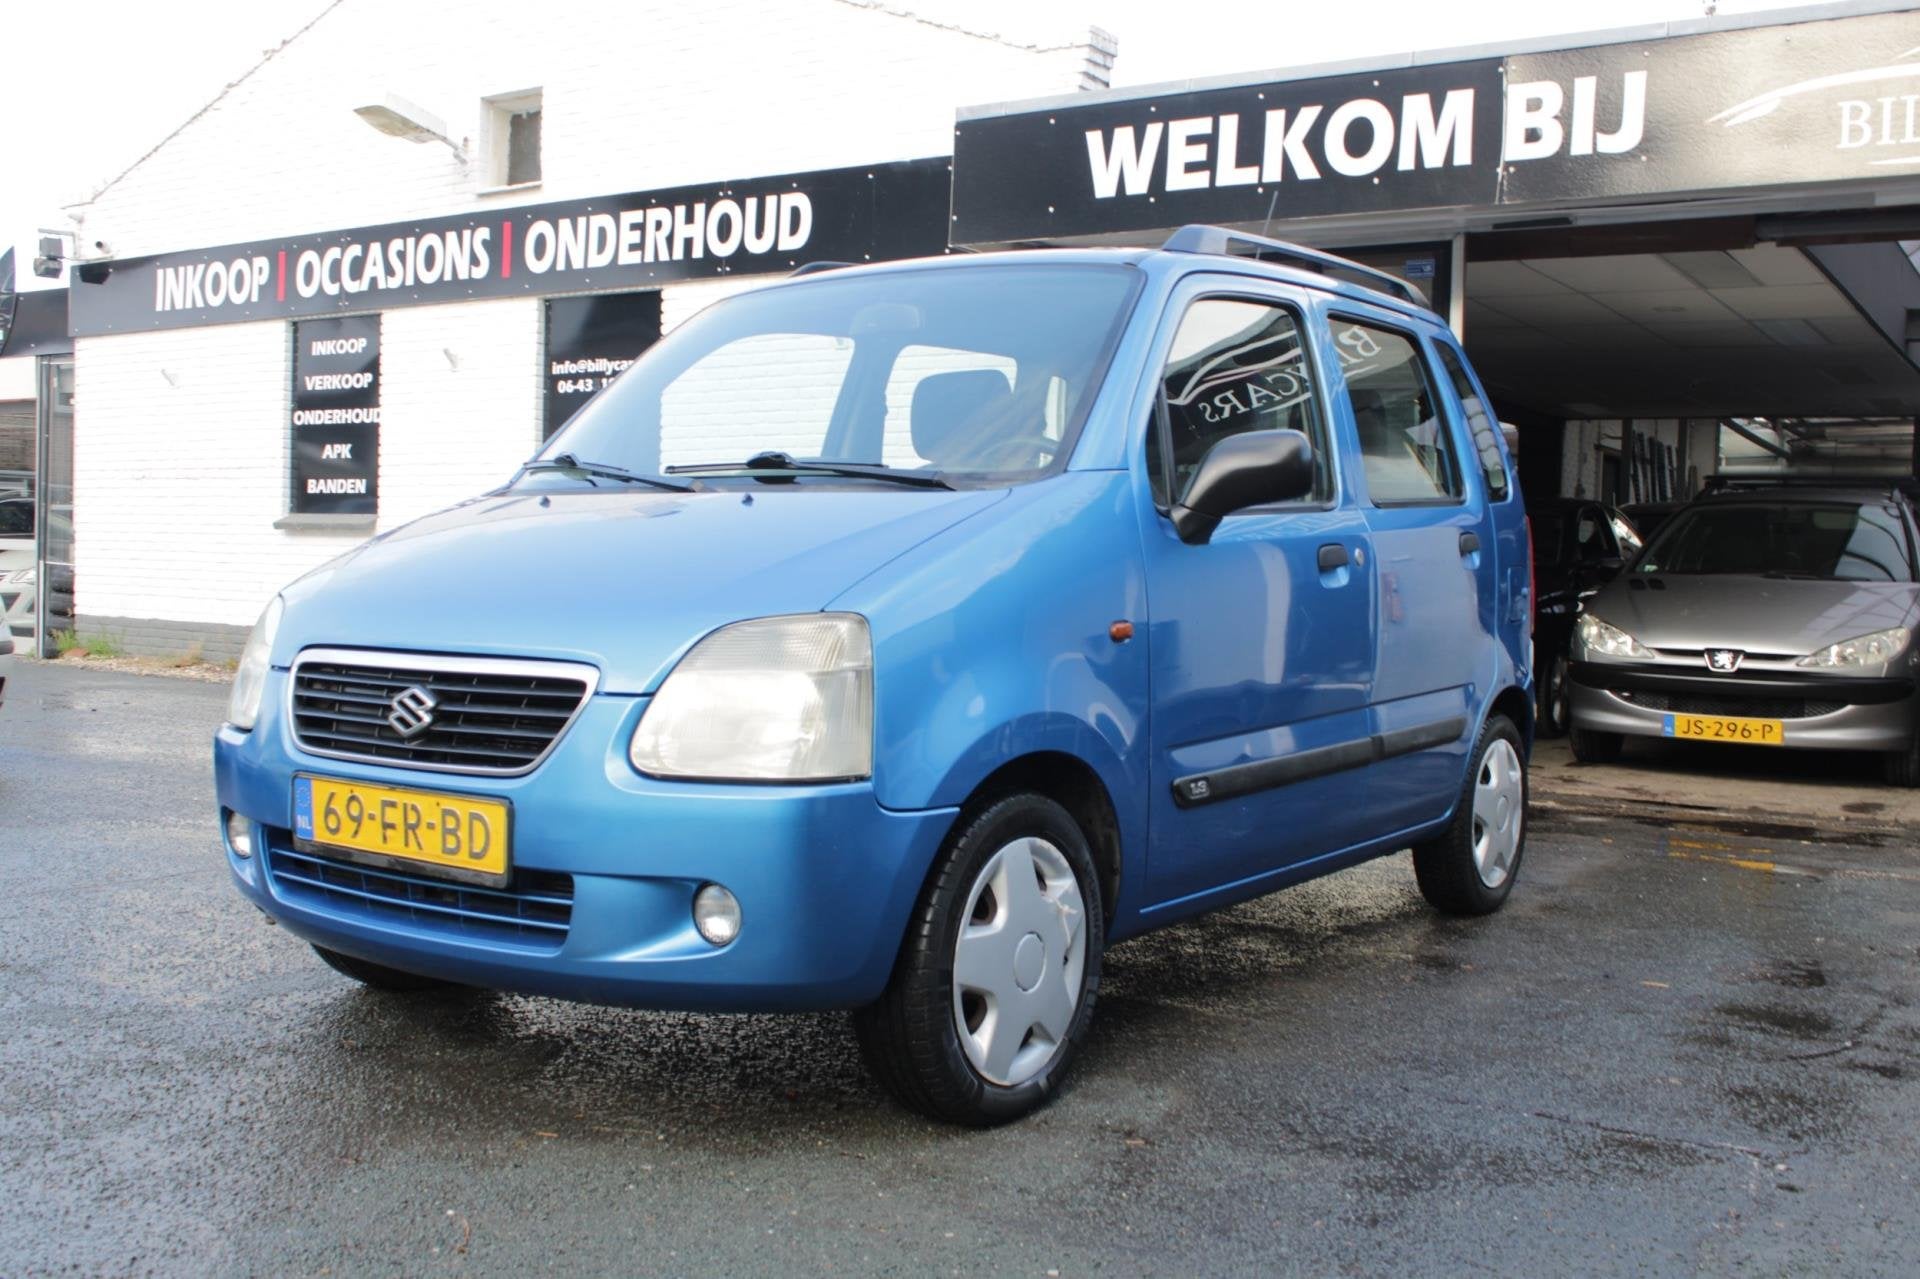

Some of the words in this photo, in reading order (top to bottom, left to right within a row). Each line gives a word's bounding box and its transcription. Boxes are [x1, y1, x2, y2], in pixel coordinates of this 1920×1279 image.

[1085, 88, 1475, 199] WELKOM
[1504, 70, 1648, 162] BIJ
[155, 255, 270, 312] INKOOP
[297, 226, 491, 299] OCCASIONS
[524, 192, 813, 274] ONDERHOUD
[311, 338, 367, 356] INKOOP
[305, 373, 373, 391] VERKOOP
[557, 378, 594, 394] 06-43
[293, 408, 381, 425] ONDERHOUD
[322, 443, 353, 460] APK
[307, 479, 366, 494] BANDEN
[1682, 719, 1774, 739] JS-296-P
[324, 791, 490, 860] 69-FR-BD
